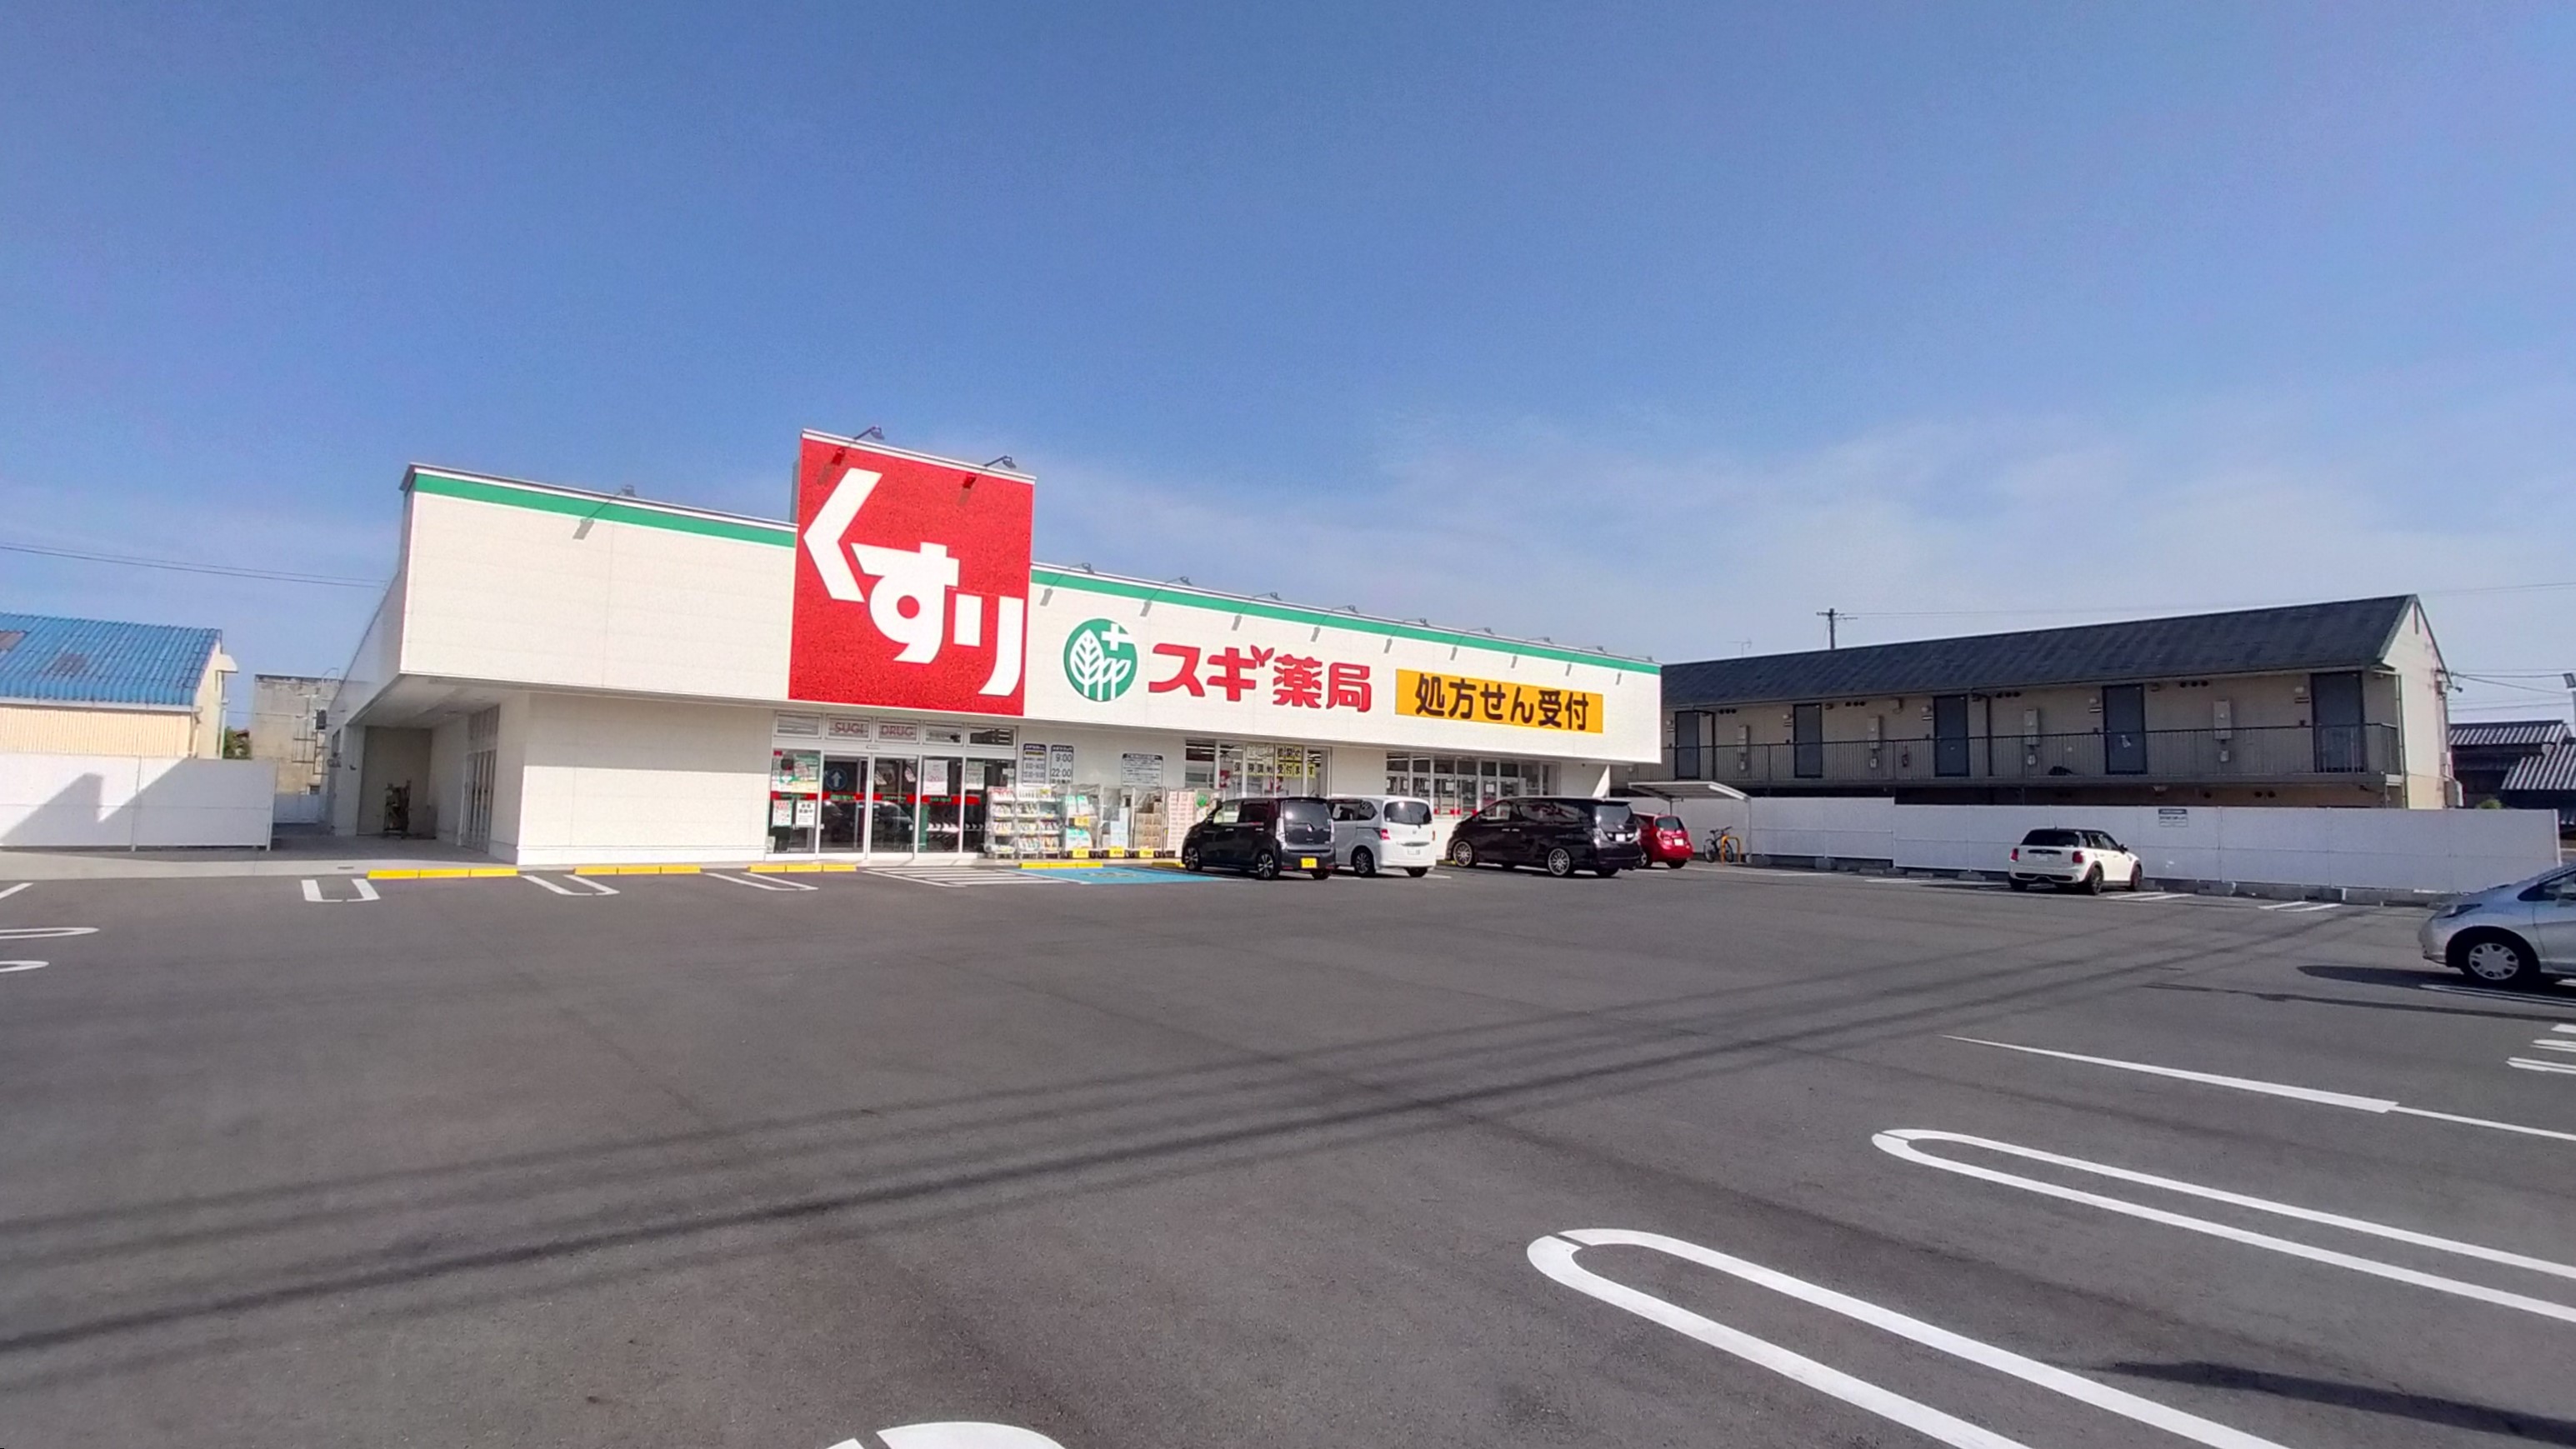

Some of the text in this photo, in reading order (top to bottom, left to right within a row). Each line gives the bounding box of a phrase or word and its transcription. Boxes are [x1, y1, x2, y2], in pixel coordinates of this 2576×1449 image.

[803, 467, 1024, 697] くすり
[1148, 642, 1372, 712] スギ薬局
[1415, 672, 1589, 731] 処方せん受付
[834, 722, 914, 737] SUGI DRUG
[1051, 767, 1073, 778] 22:00
[1055, 752, 1073, 762] 9:00
